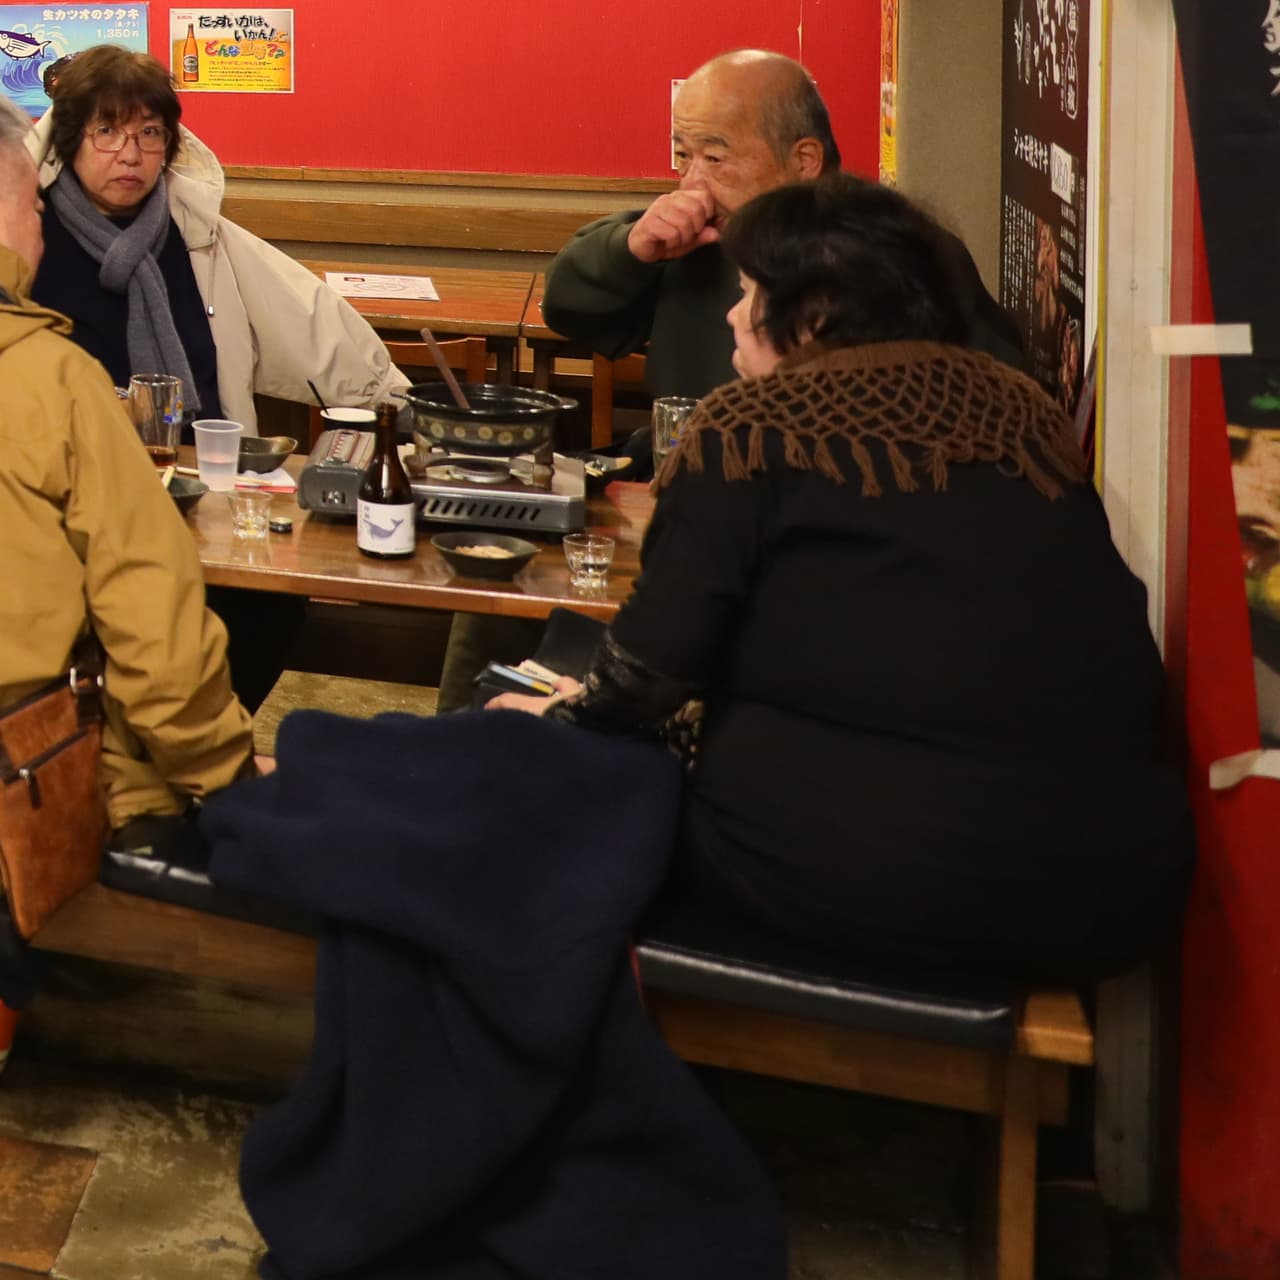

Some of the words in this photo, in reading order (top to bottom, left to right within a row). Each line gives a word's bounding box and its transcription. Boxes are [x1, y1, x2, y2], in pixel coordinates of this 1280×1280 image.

[43, 8, 140, 21] 生カツオのタタキ
[198, 15, 270, 28] たっすいがは、
[234, 28, 275, 42] いかん!
